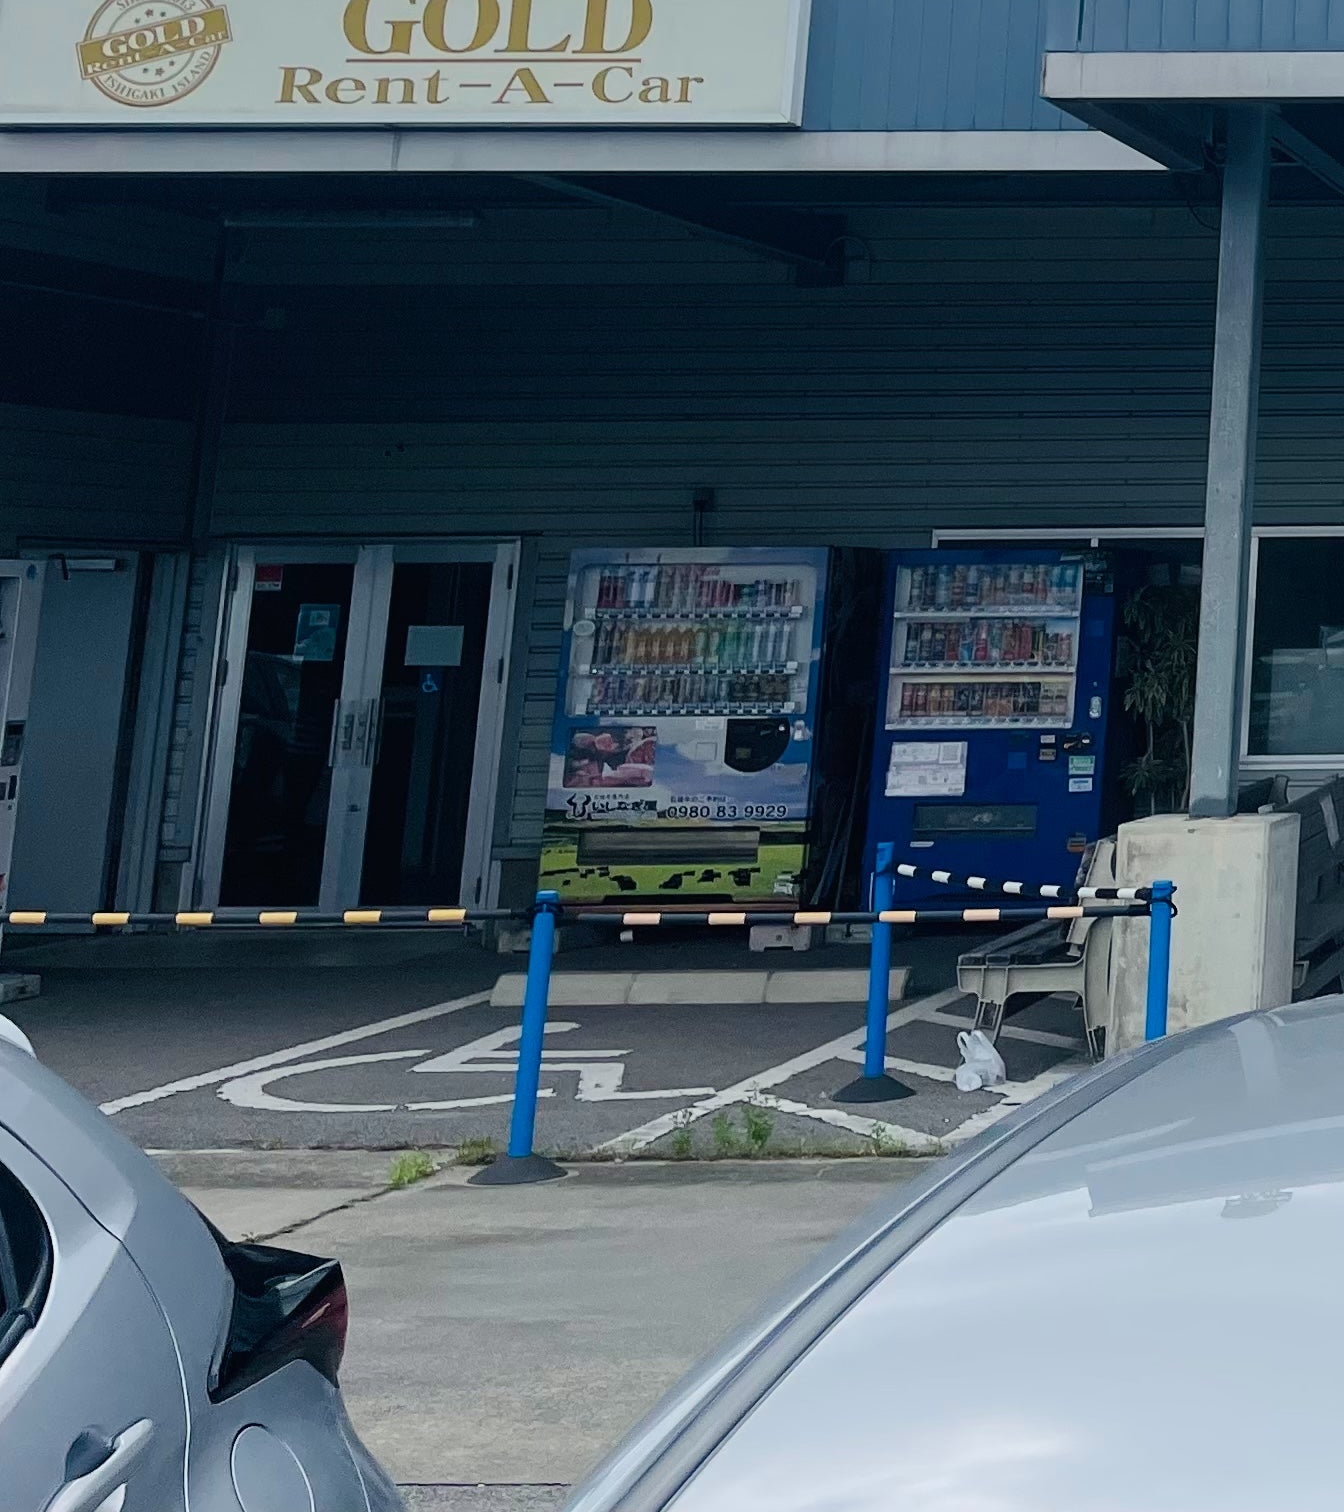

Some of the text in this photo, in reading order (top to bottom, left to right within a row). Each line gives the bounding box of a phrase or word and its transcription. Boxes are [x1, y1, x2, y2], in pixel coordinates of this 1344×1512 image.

[102, 16, 205, 57] GOLD
[104, 50, 211, 100] ISHIGAKI ISLAND
[275, 66, 704, 105] Rent-A-Car
[667, 805, 787, 818] 0980 83 9929
